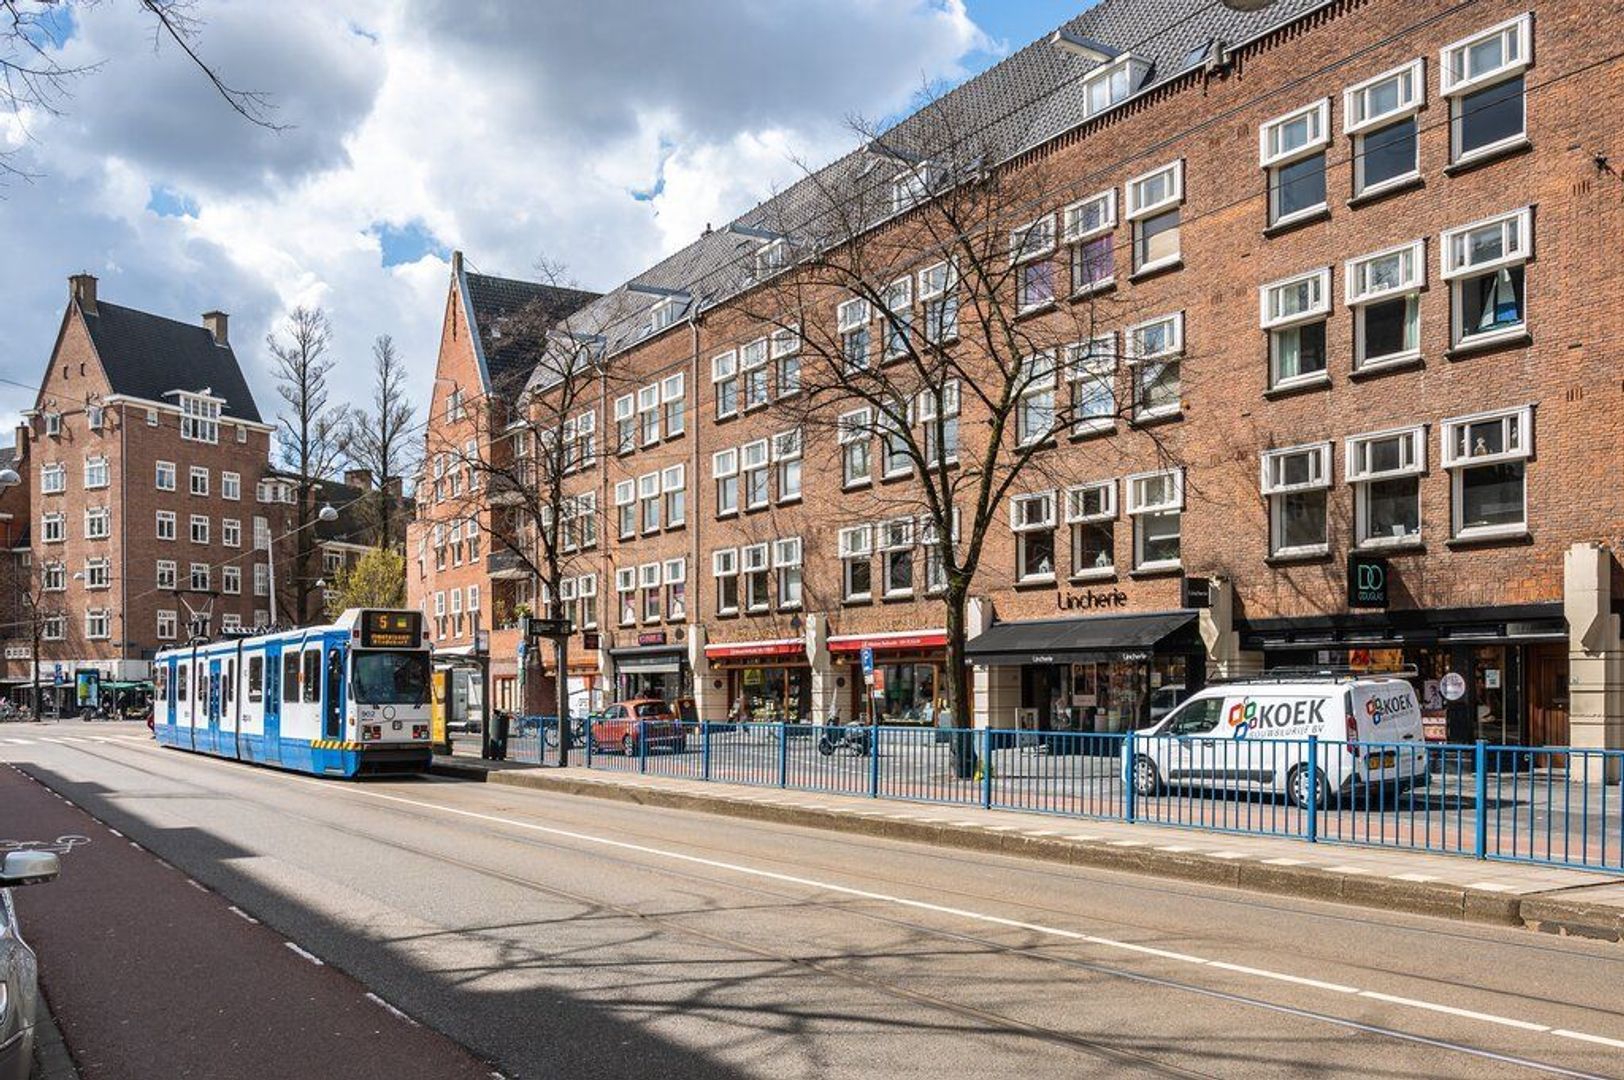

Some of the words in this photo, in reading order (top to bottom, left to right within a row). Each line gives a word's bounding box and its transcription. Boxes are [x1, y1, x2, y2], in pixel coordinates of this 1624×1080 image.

[1057, 588, 1128, 610] Lincherie
[1122, 653, 1148, 661] Lincherie
[1259, 699, 1327, 729] KOEK
[1383, 694, 1414, 715] KOEK
